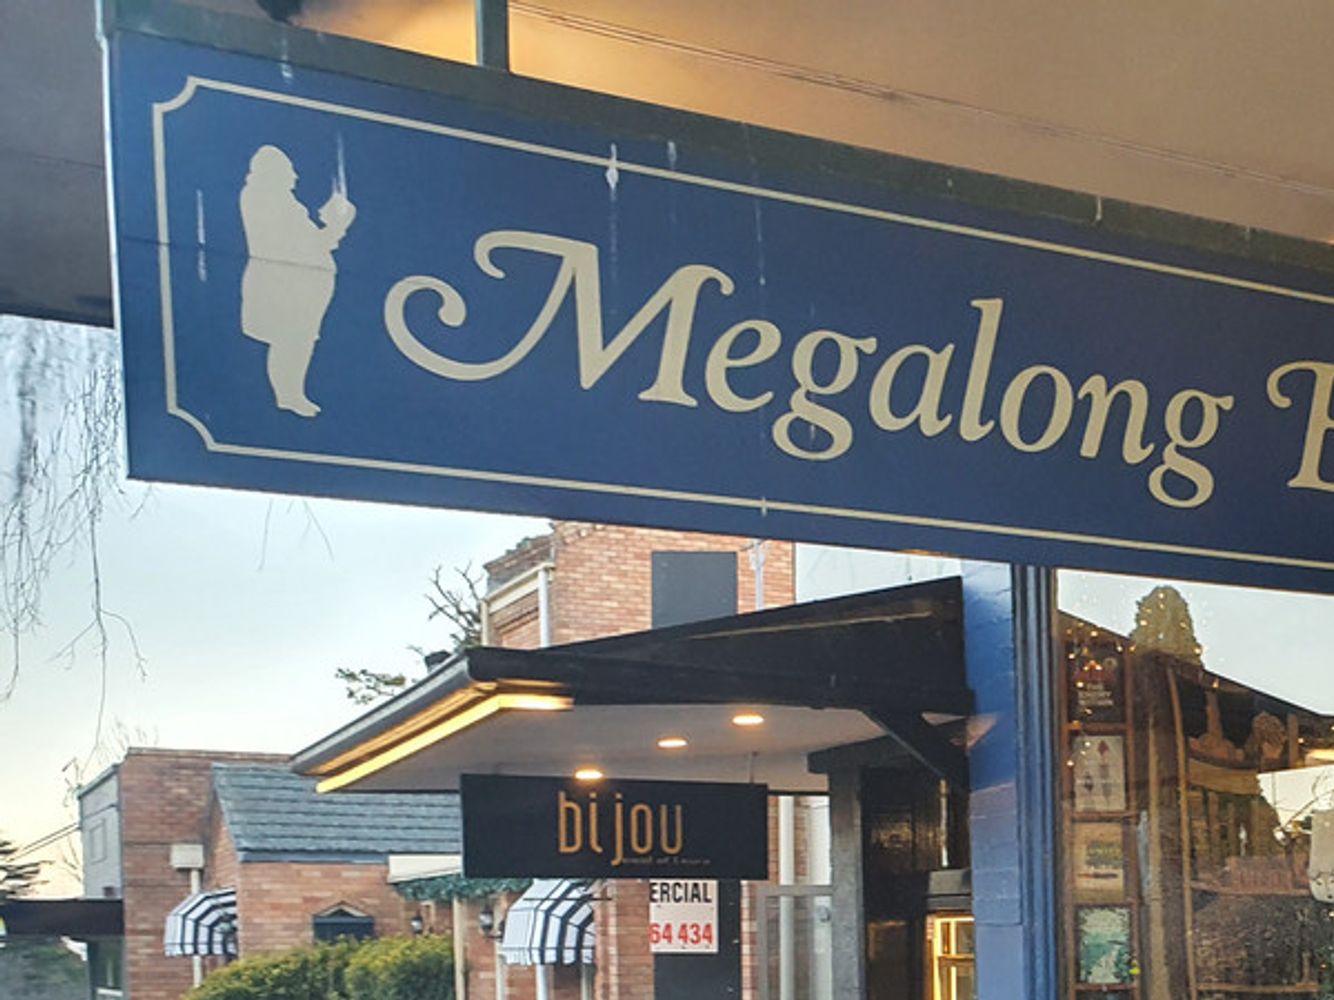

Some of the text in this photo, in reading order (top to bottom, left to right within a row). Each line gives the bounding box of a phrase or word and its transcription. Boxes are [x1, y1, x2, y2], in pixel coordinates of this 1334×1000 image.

[384, 230, 1234, 508] Megalong
[558, 790, 684, 866] bijou
[650, 882, 714, 903] ERCIAL
